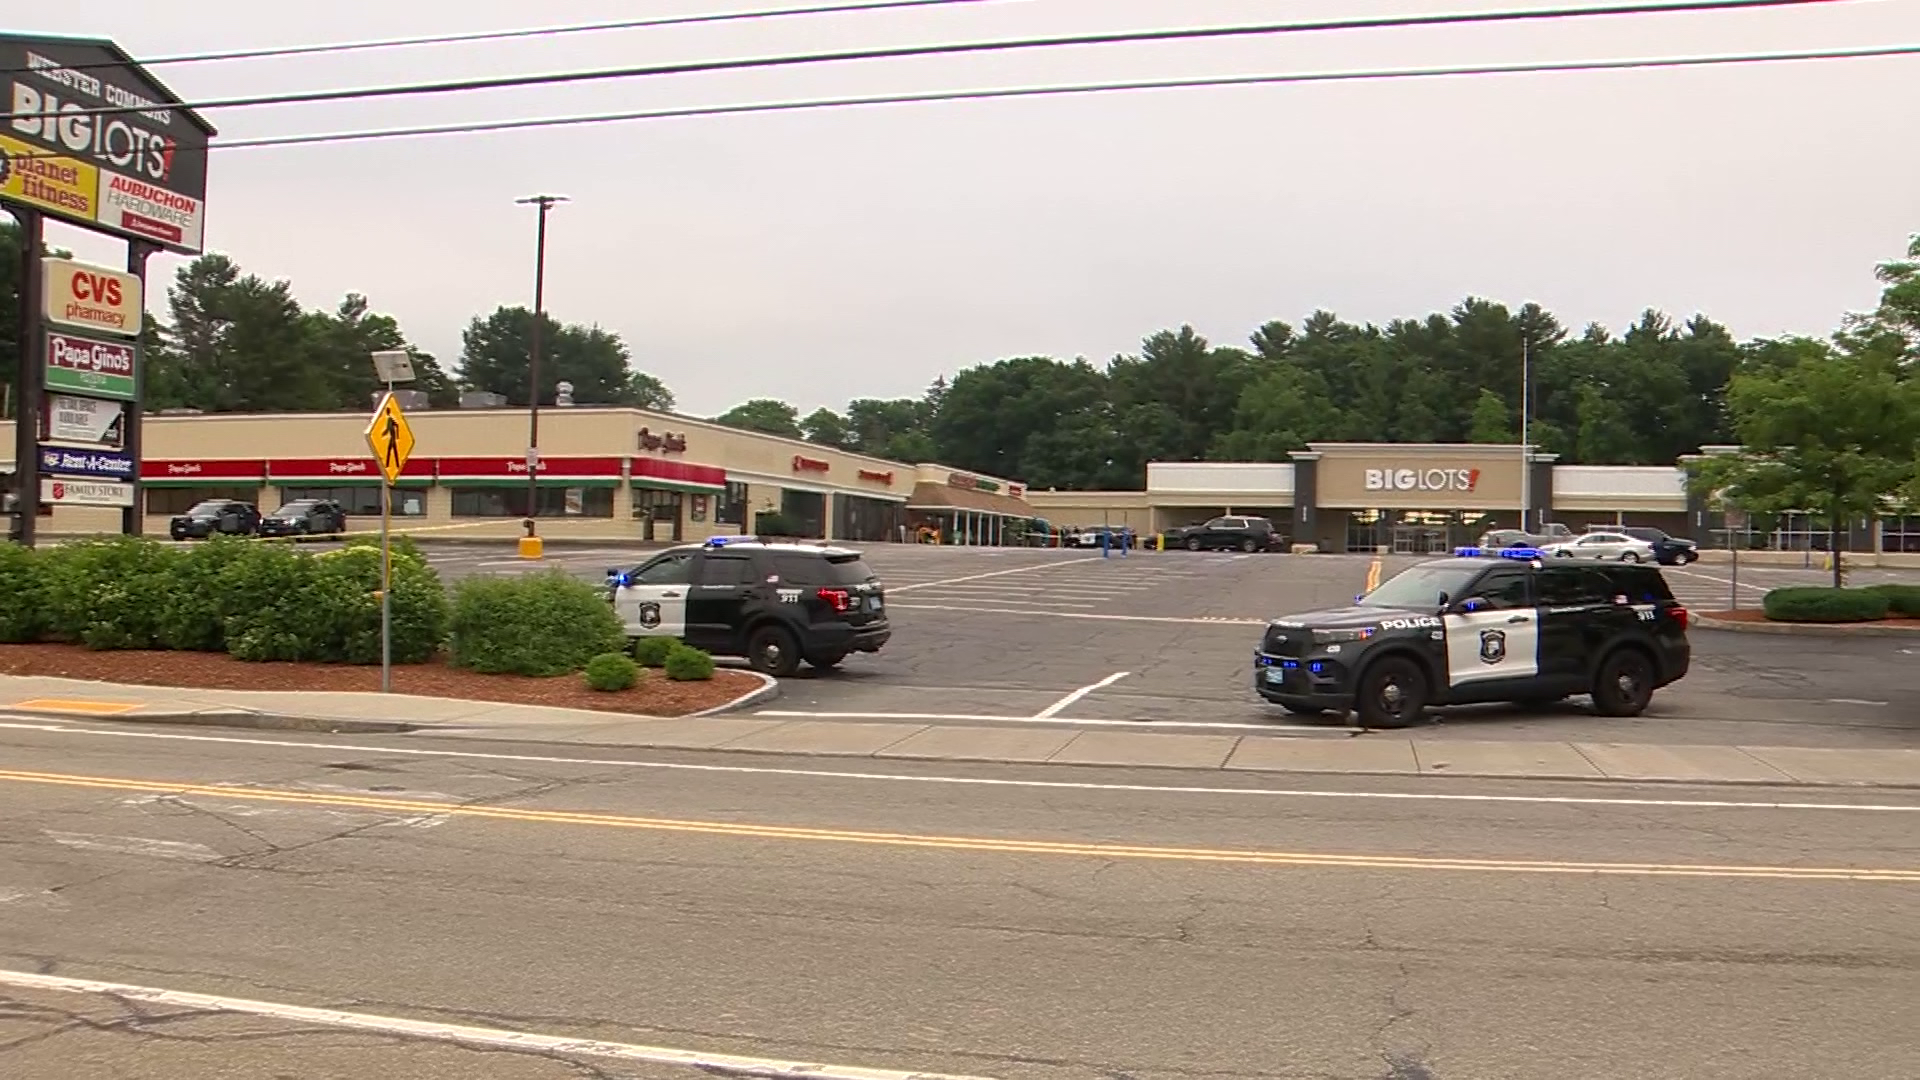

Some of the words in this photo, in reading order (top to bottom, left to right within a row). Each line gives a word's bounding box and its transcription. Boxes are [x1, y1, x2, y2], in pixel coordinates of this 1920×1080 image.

[16, 150, 77, 186] planet
[24, 174, 88, 212] fitness
[107, 190, 193, 228] HARDWARE
[110, 177, 195, 213] AUBUCHON
[72, 271, 122, 306] CVS
[66, 302, 126, 328] pharmacy
[52, 337, 90, 368] Papa
[65, 484, 97, 495] FAMILY
[1380, 617, 1442, 630] POLICE
